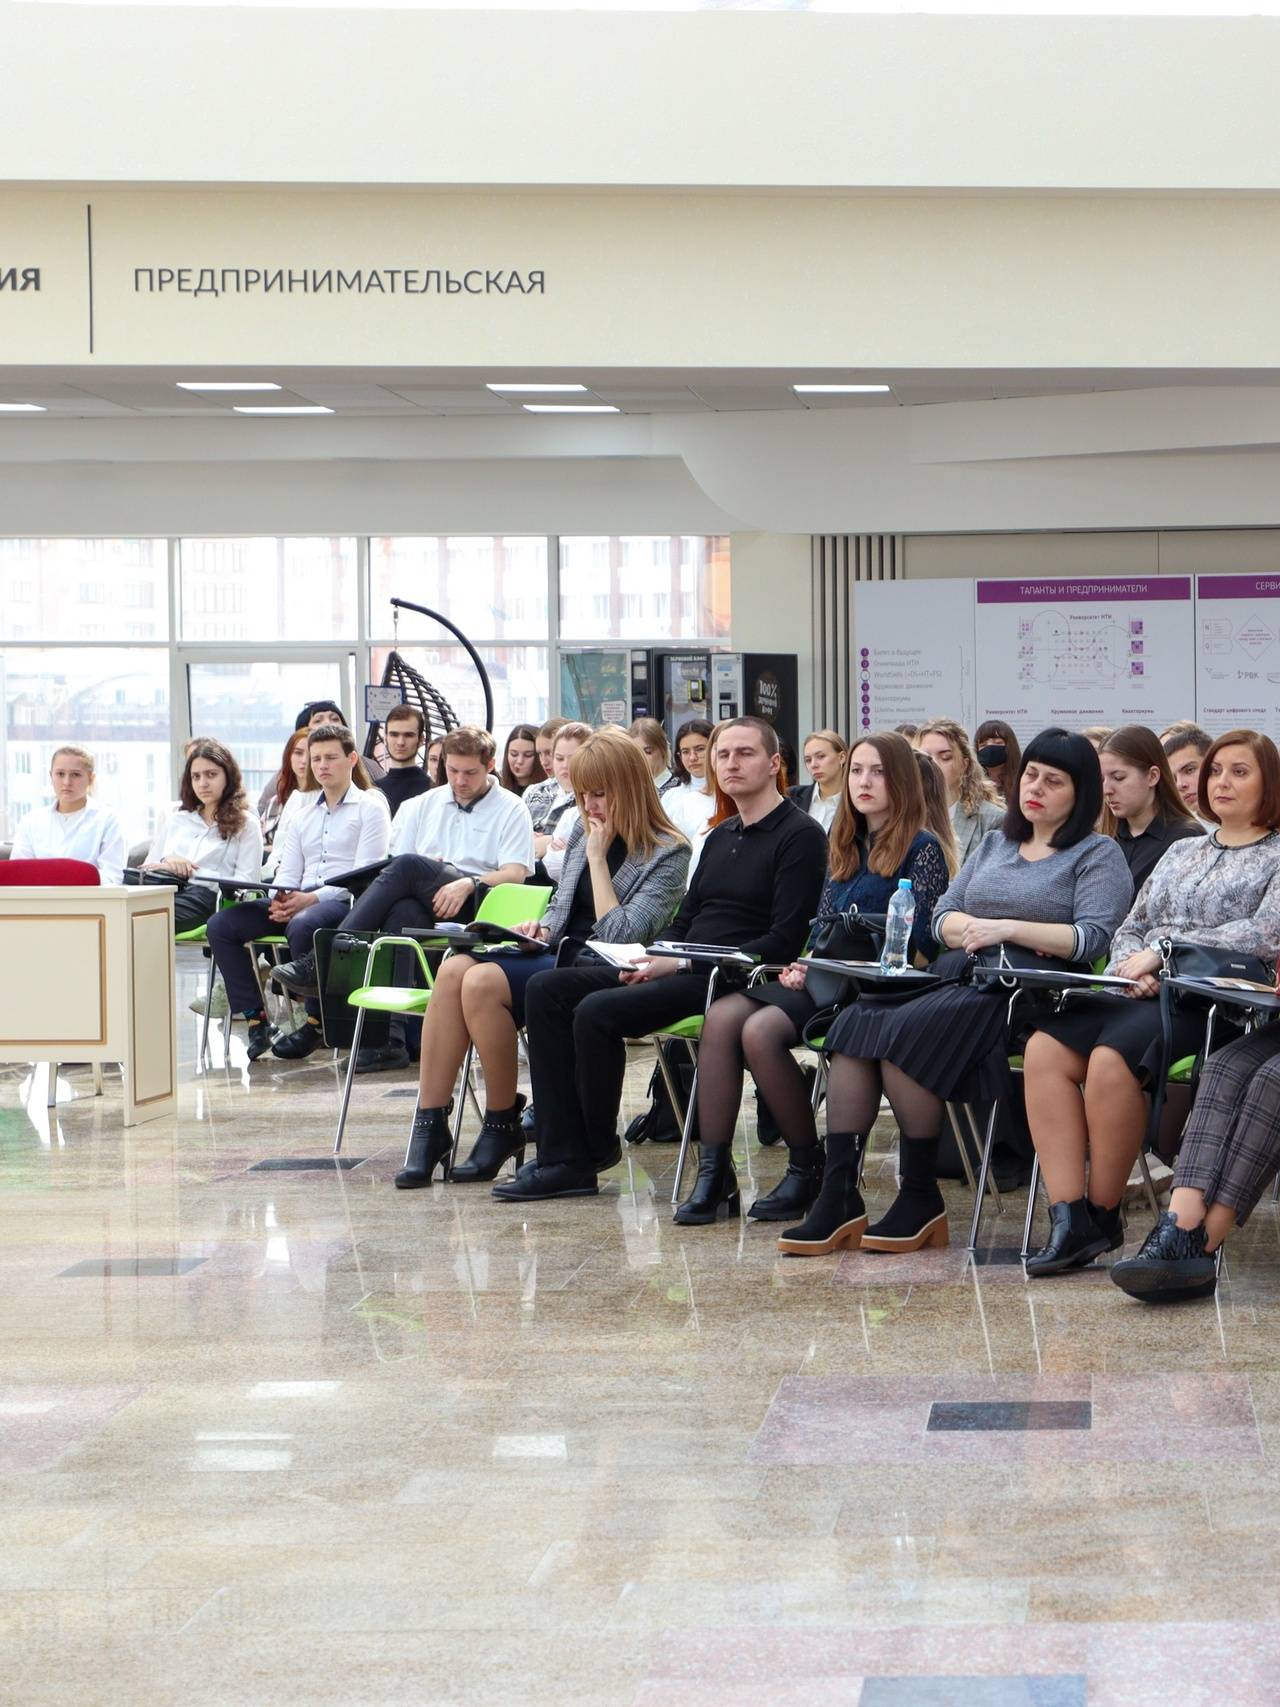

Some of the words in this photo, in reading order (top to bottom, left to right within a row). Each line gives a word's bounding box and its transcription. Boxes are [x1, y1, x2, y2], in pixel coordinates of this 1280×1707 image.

[133, 267, 546, 297] ПРЕДПРИНИМАТЕЛЬСКАЯ
[1020, 585, 1057, 595] ТАЛАНТЫ
[1059, 585, 1065, 594] И
[1066, 584, 1148, 595] ПРЕДПРИНИМАТЕЛИ
